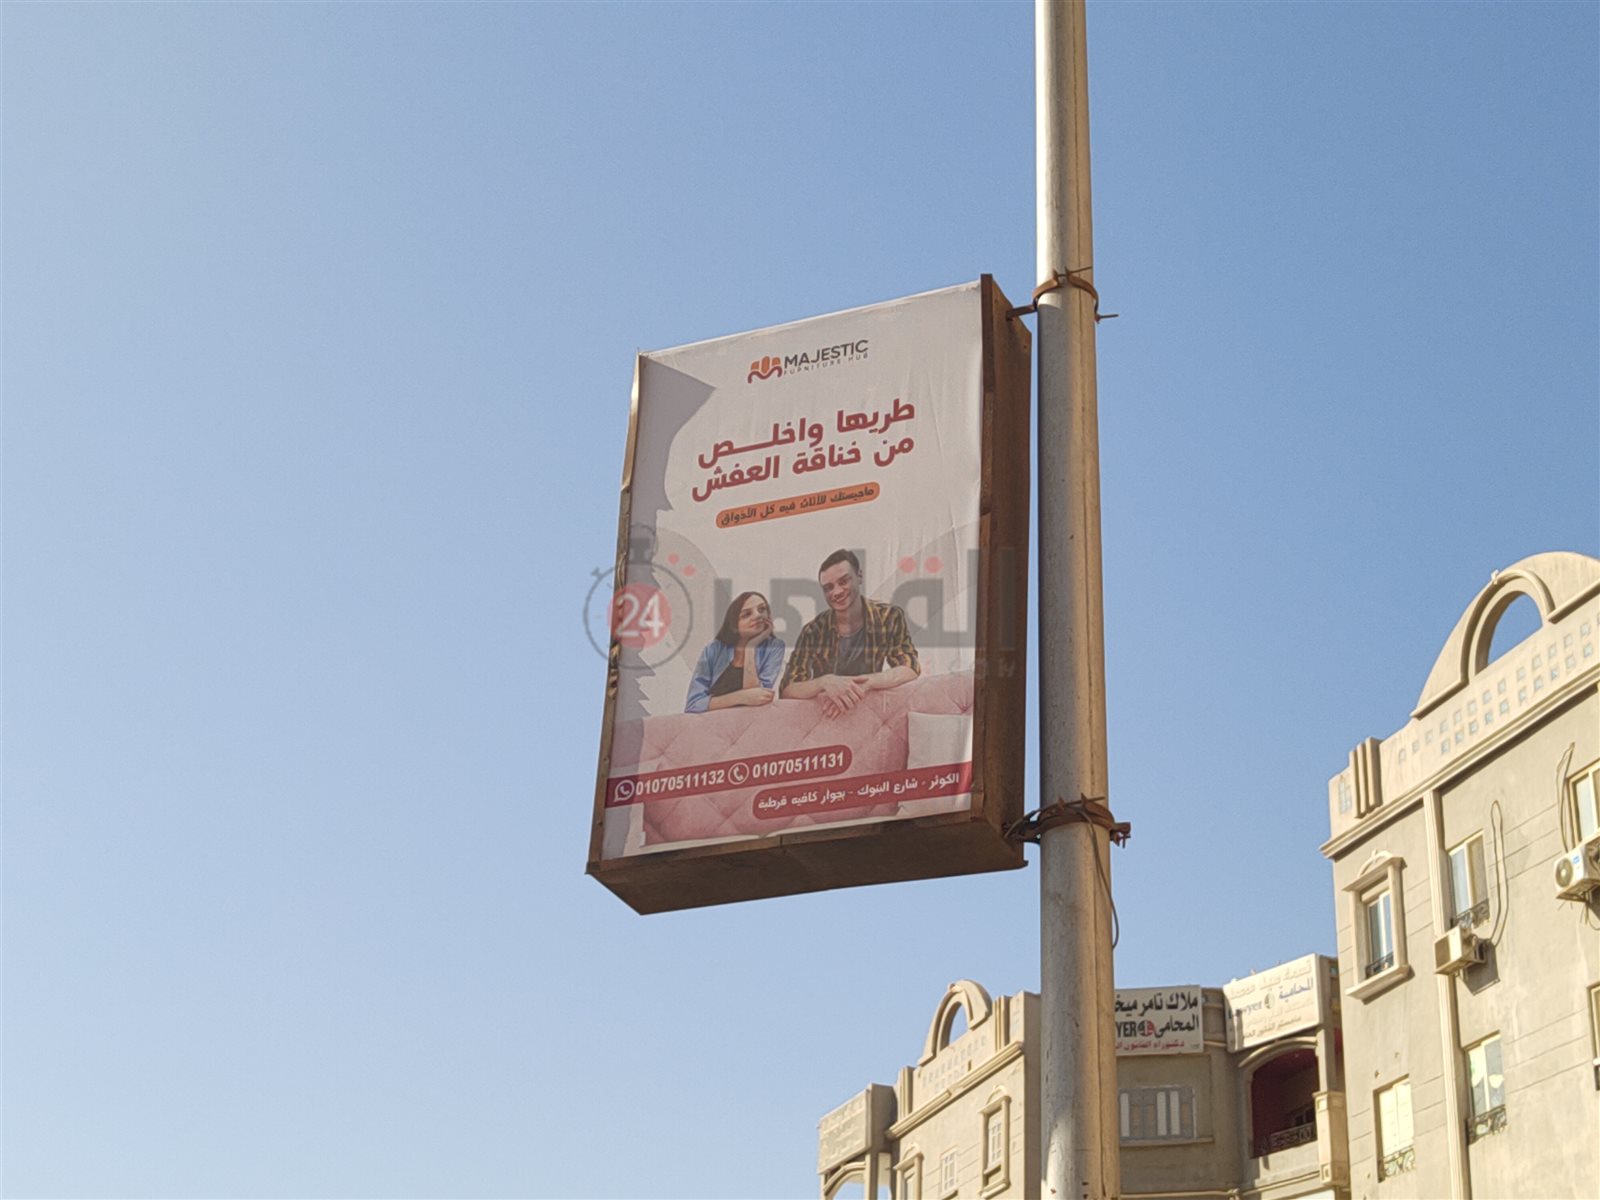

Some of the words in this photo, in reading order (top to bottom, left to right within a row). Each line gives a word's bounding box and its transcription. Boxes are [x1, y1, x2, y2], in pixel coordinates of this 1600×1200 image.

[784, 340, 869, 369] MAJESTIC
[784, 359, 842, 376] FURNITURE
[836, 398, 915, 434] طريها
[792, 441, 861, 475] خناقة
[873, 437, 914, 467] من
[692, 455, 780, 501] العفش
[760, 505, 775, 518] كل
[779, 502, 796, 513] فيه
[636, 769, 725, 797] 01070511132
[752, 752, 844, 779] 01070511131
[928, 772, 960, 790] الكوثر
[857, 782, 890, 798] البنوك
[893, 779, 918, 794] شارع
[791, 792, 818, 807] كافيه
[820, 788, 846, 805] بجوار
[1115, 993, 1138, 1017] ميخ
[1138, 992, 1164, 1017] تامر
[1165, 991, 1199, 1011] ملاك
[1115, 1021, 1137, 1038] YER
